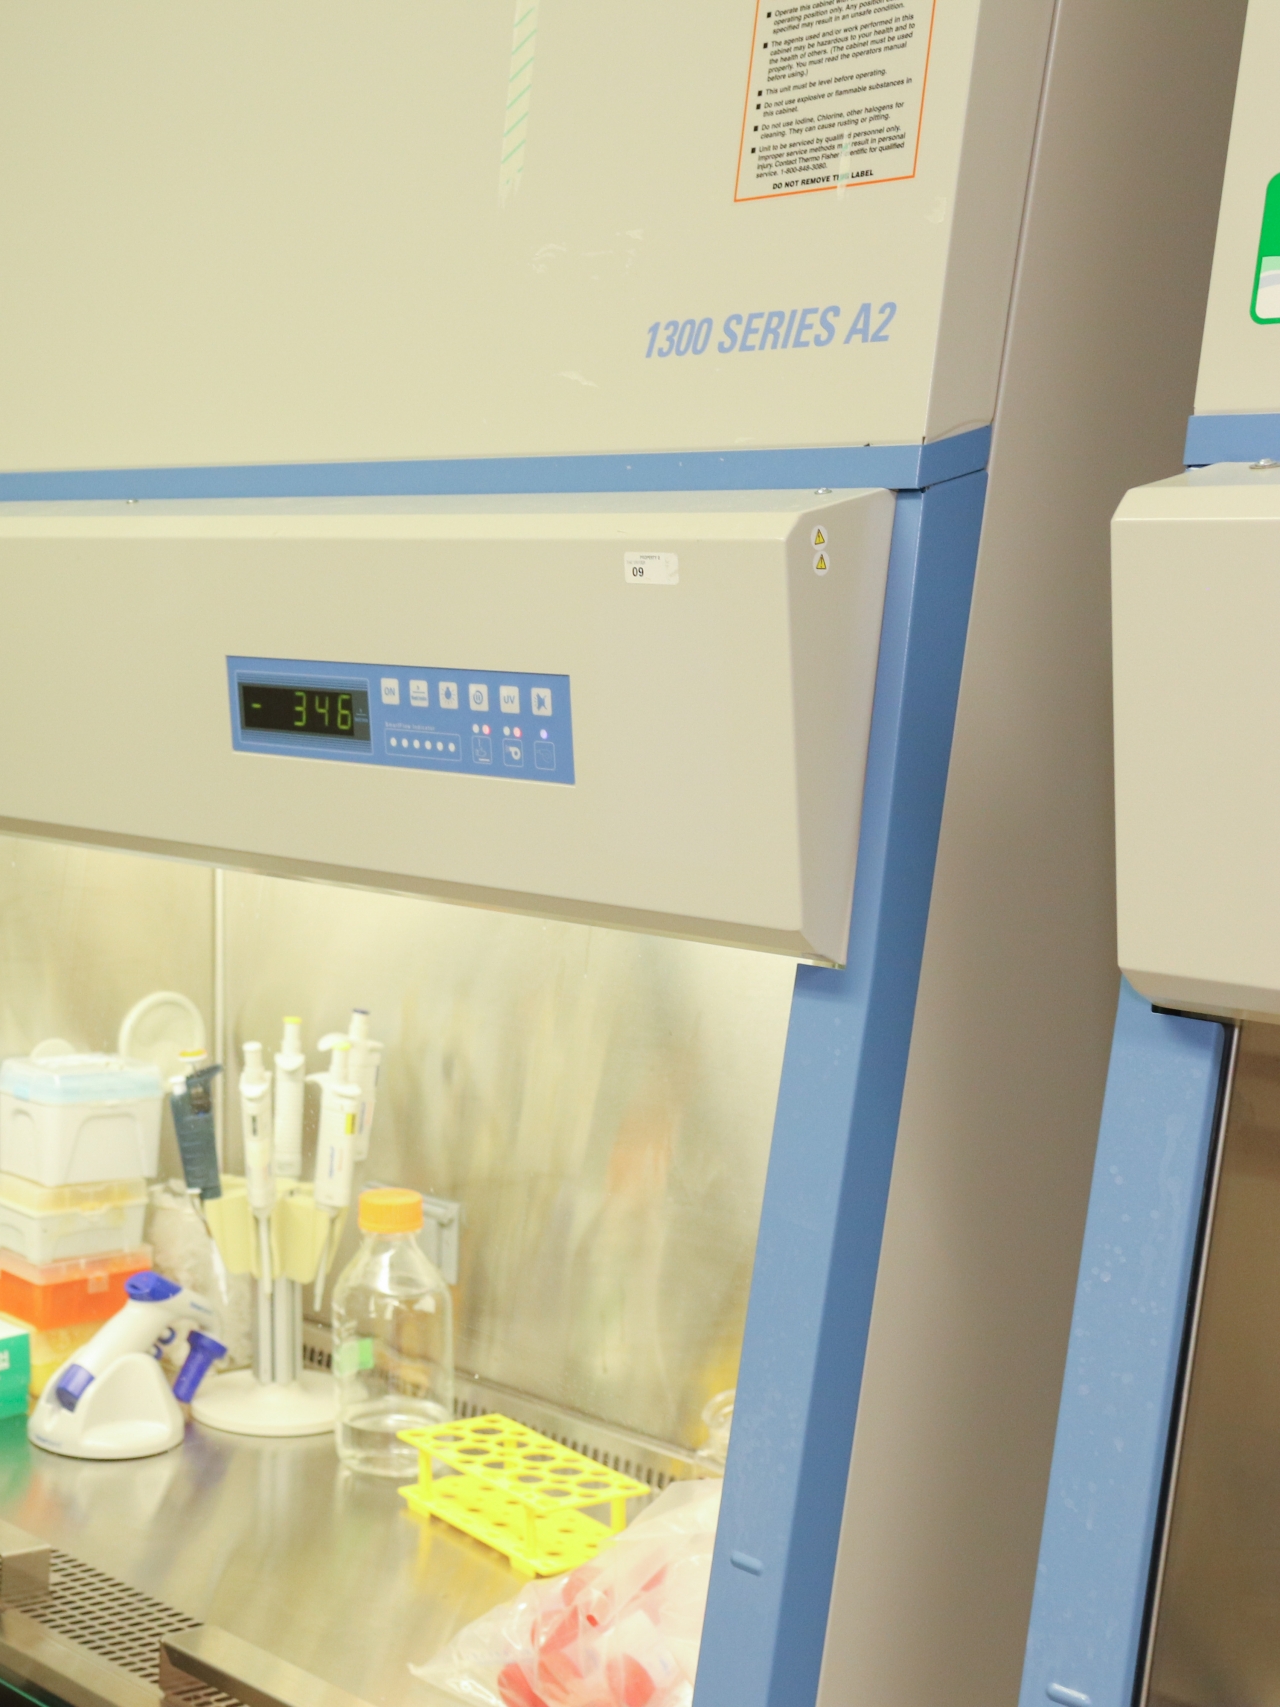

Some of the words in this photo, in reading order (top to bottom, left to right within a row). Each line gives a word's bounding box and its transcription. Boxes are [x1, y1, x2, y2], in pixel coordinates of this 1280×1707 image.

[772, 23, 800, 35] specified
[815, 16, 833, 25] result
[841, 13, 850, 21] an
[850, 8, 872, 19] unsafe
[873, 2, 905, 14] condition.
[773, 15, 802, 26] operating
[803, 9, 828, 20] position
[829, 5, 843, 14] only.
[774, 6, 798, 17] Operate
[812, 0, 835, 9] cabinet
[769, 47, 791, 56] cabinet
[816, 36, 848, 46] hazardous
[858, 31, 872, 39] your
[873, 26, 893, 35] health
[894, 23, 907, 32] and
[783, 36, 804, 46] agents
[805, 32, 820, 41] used
[843, 24, 858, 33] work
[859, 17, 893, 31] performed
[901, 13, 914, 21] this
[780, 54, 798, 62] health
[830, 45, 844, 54] (The
[845, 40, 869, 50] cabinet
[870, 36, 886, 44] must
[896, 30, 913, 40] used
[808, 57, 824, 66] must
[824, 54, 839, 63] read
[851, 46, 882, 58] operators
[883, 40, 907, 52] manual
[766, 73, 786, 82] before
[779, 84, 791, 93] unit
[792, 82, 808, 90] must
[817, 77, 833, 86] level
[833, 74, 854, 84] before
[855, 68, 887, 80] operating.
[763, 101, 772, 109] Do
[796, 92, 826, 103] explosive
[834, 85, 867, 96] flammable
[868, 78, 905, 91] substances
[761, 123, 770, 131] Do
[816, 112, 843, 122] Chlorine,
[846, 108, 863, 117] other
[864, 103, 894, 113] halogens
[762, 110, 774, 118] this
[775, 105, 799, 116] cabinet.
[758, 144, 771, 153] Unit
[788, 138, 815, 148] serviced
[852, 126, 885, 139] personnel
[885, 124, 901, 133] only.
[760, 130, 787, 140] cleaning.
[789, 127, 803, 135] They
[817, 122, 836, 130] cause
[836, 118, 859, 127] rusting
[868, 113, 891, 123] pitting.
[757, 152, 784, 161] Improper
[786, 148, 807, 157] service
[809, 144, 835, 152] methods
[851, 138, 869, 147] result
[877, 131, 906, 144] personal
[774, 158, 797, 167] Contact
[798, 155, 820, 163] Thermo
[821, 152, 840, 160] Fisher
[878, 140, 905, 153] qualified
[755, 170, 778, 179] service.
[772, 181, 783, 190] DO
[784, 179, 799, 188] NOT
[800, 174, 831, 185] REMOVE
[850, 168, 874, 179] LABEL
[645, 317, 714, 358] 1300
[717, 305, 841, 354] SERIES
[843, 301, 897, 345] A2
[632, 566, 644, 577] 09
[384, 687, 396, 697] ON
[503, 695, 516, 704] UV
[293, 691, 353, 731] 346
